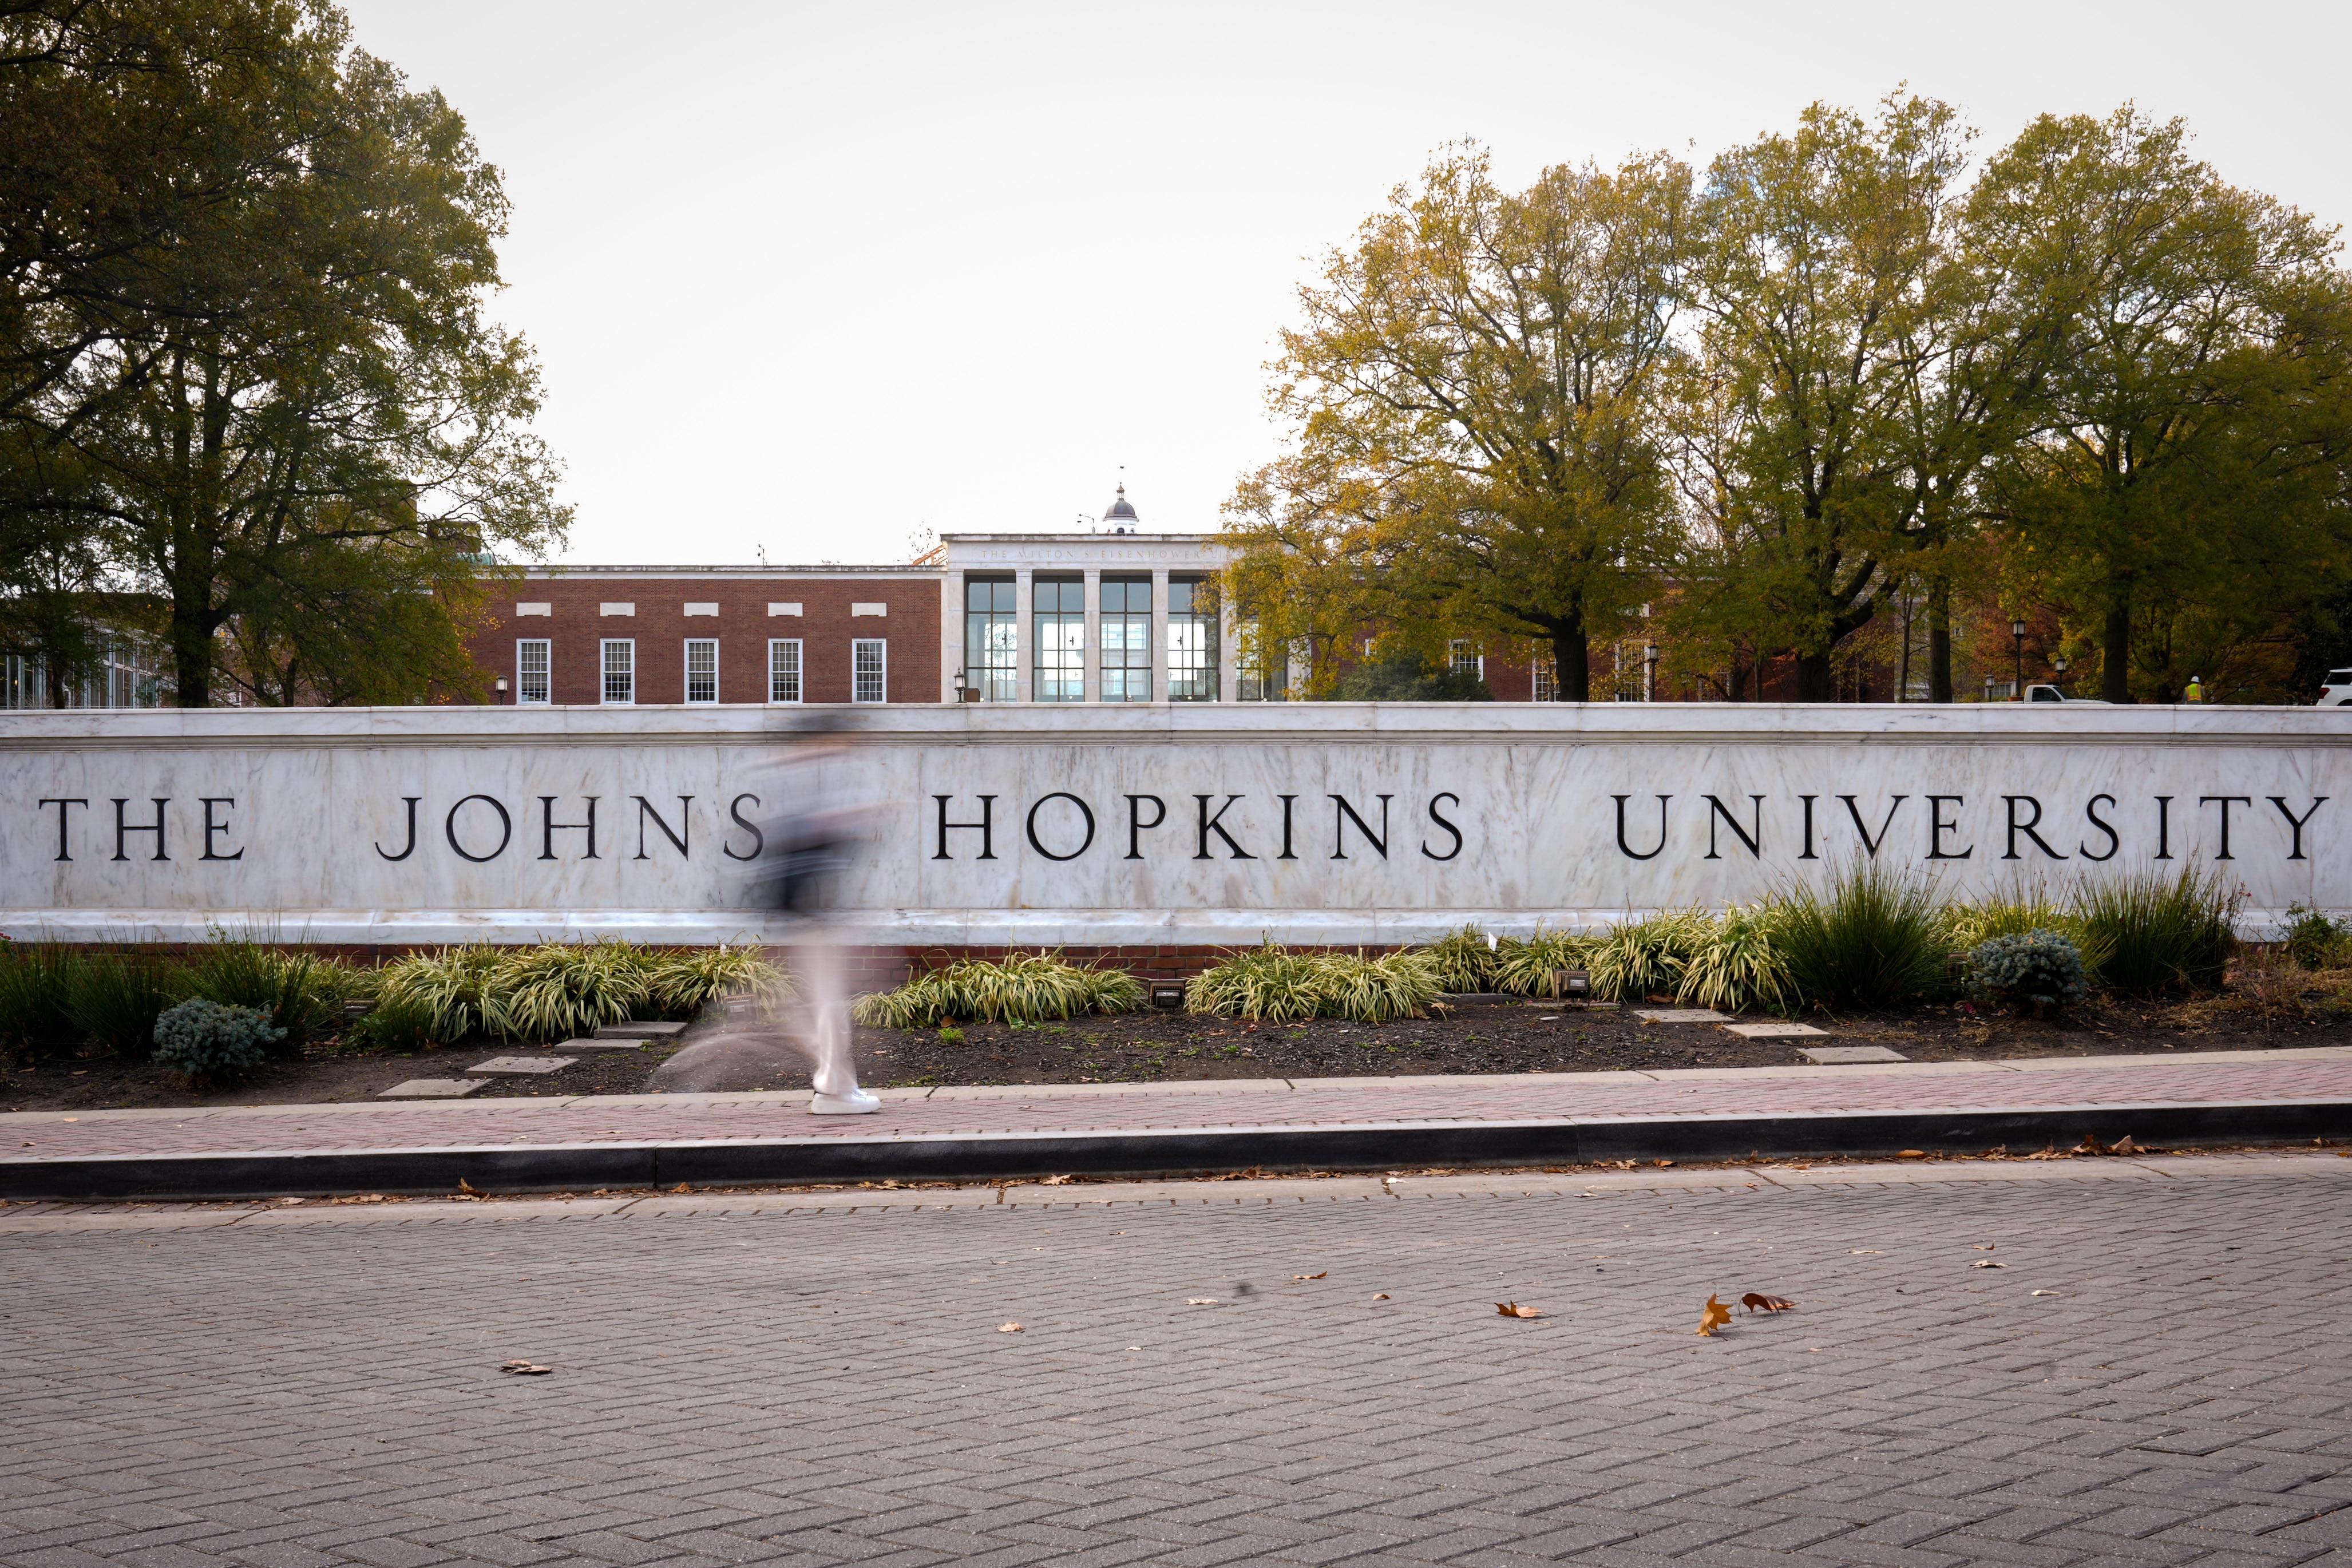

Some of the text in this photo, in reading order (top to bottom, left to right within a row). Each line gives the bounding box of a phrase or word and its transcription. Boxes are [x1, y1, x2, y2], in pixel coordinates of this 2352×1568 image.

[982, 550, 1007, 559] THE
[1018, 549, 1074, 559] MILTON
[1101, 550, 1201, 559] EISENHOWER
[38, 793, 2330, 862] THE JOHNS HOPKINS UNIVERSITY
